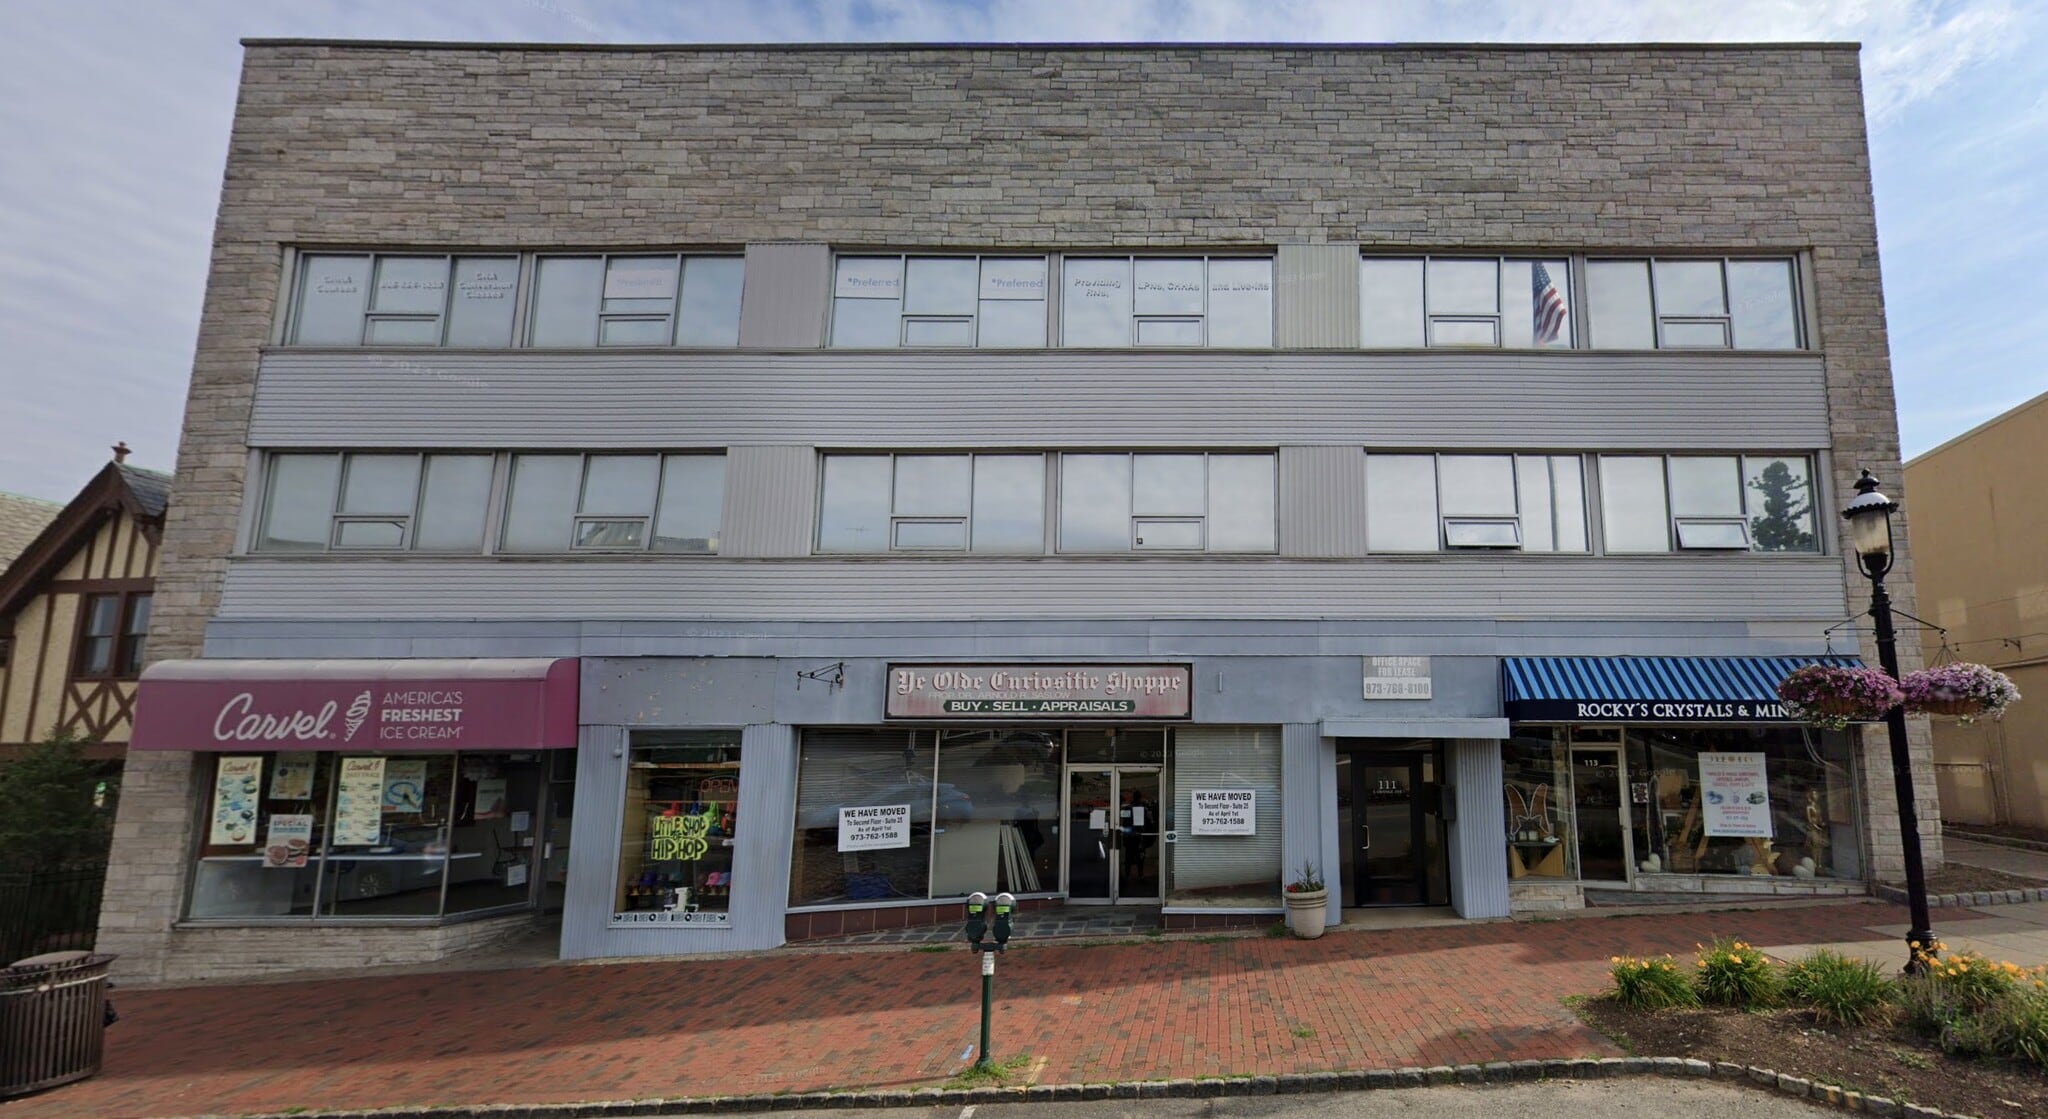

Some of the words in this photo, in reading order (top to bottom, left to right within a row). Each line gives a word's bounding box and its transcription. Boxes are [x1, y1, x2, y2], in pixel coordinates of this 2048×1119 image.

[897, 670, 926, 696] Ye
[932, 670, 984, 692] Olde
[1104, 670, 1182, 696] Shoppe
[382, 691, 463, 705] AMERICA'S
[951, 701, 981, 711] BUY
[992, 701, 1028, 711] SELL
[1039, 701, 1129, 711] APPRAISALS
[1652, 703, 1733, 717] CRYSTALS
[1737, 704, 1750, 717] &
[1755, 703, 1790, 717] MIN
[213, 692, 338, 741] Carvel
[381, 708, 463, 722] FRESHEST
[379, 725, 405, 739] ICE
[407, 725, 461, 740] CREAM
[1584, 759, 1599, 767] 113
[700, 779, 738, 792] OPEN
[1379, 780, 1397, 789] 111
[1196, 792, 1206, 801] WE
[1208, 792, 1226, 801] HAVE
[1228, 792, 1252, 801] MOVED
[844, 810, 856, 818] WE
[858, 809, 878, 817] HAVE
[880, 807, 906, 816] MOVED
[682, 816, 708, 837] SHOP
[652, 838, 676, 860] HIP
[678, 838, 706, 859] HOP
